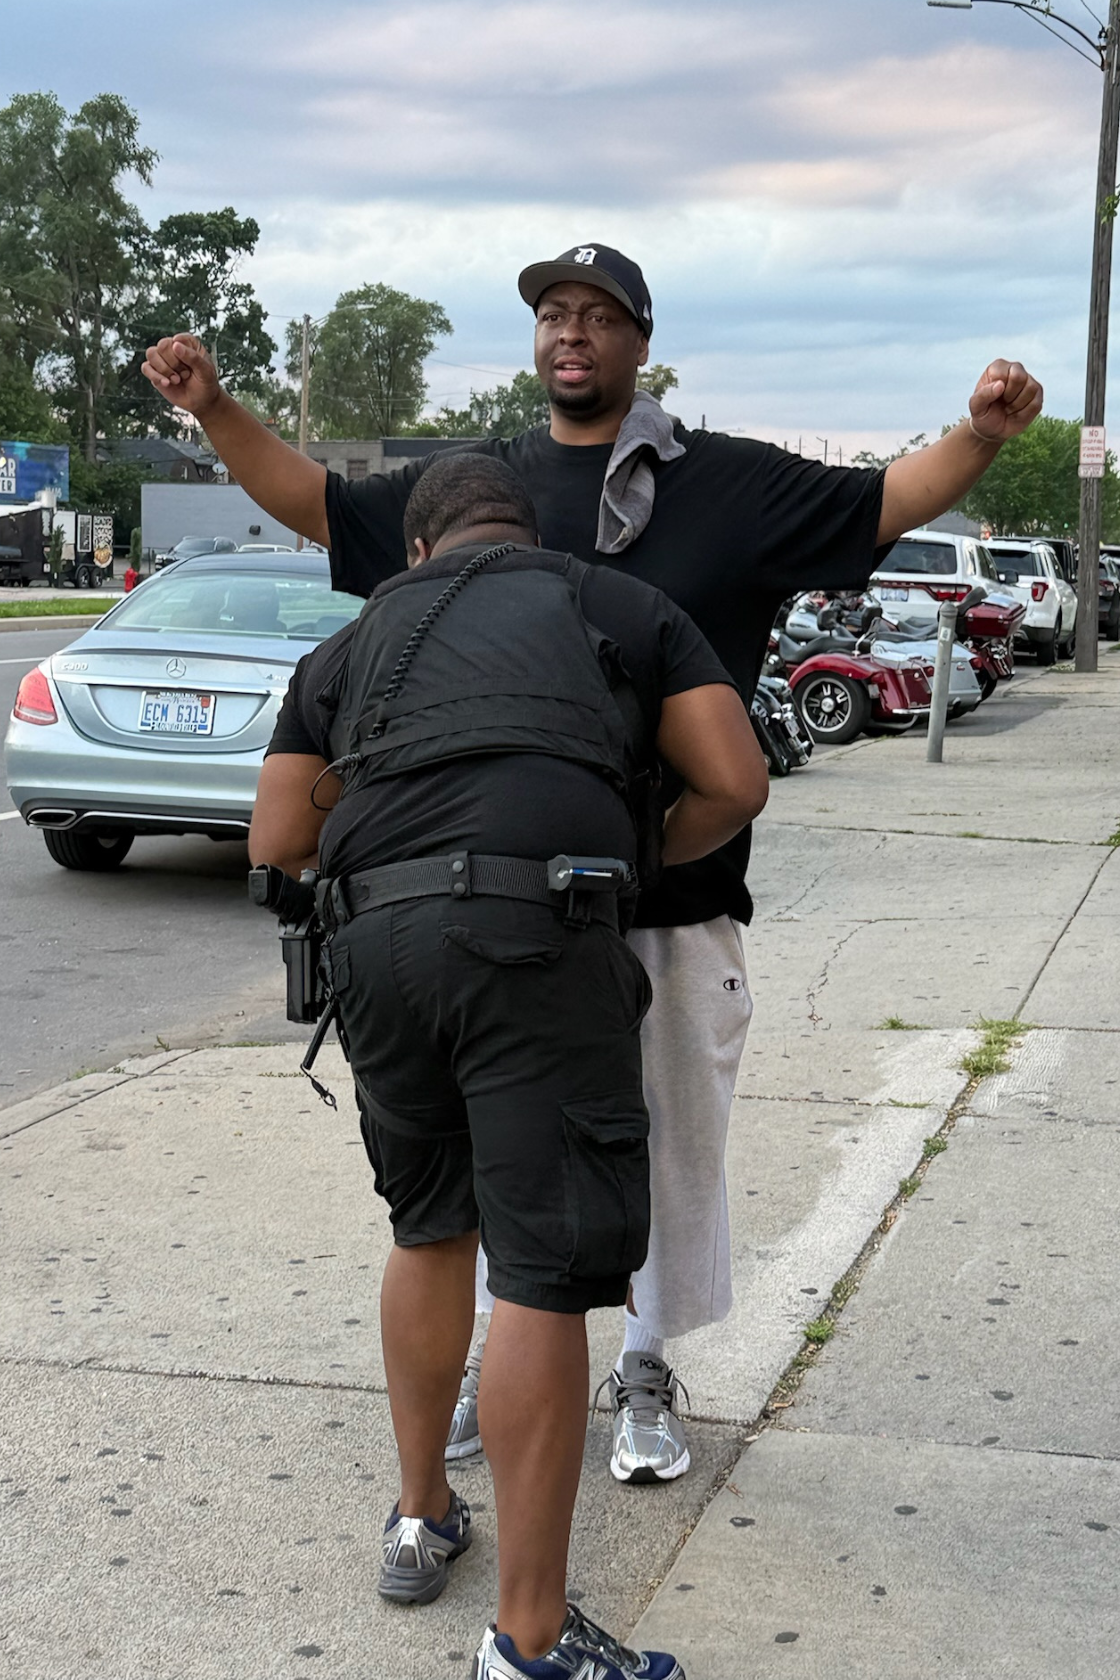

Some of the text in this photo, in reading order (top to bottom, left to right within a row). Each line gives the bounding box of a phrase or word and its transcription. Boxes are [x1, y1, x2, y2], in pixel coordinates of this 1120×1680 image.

[1089, 430, 1099, 438] NO
[144, 702, 208, 724] ECM 6315
